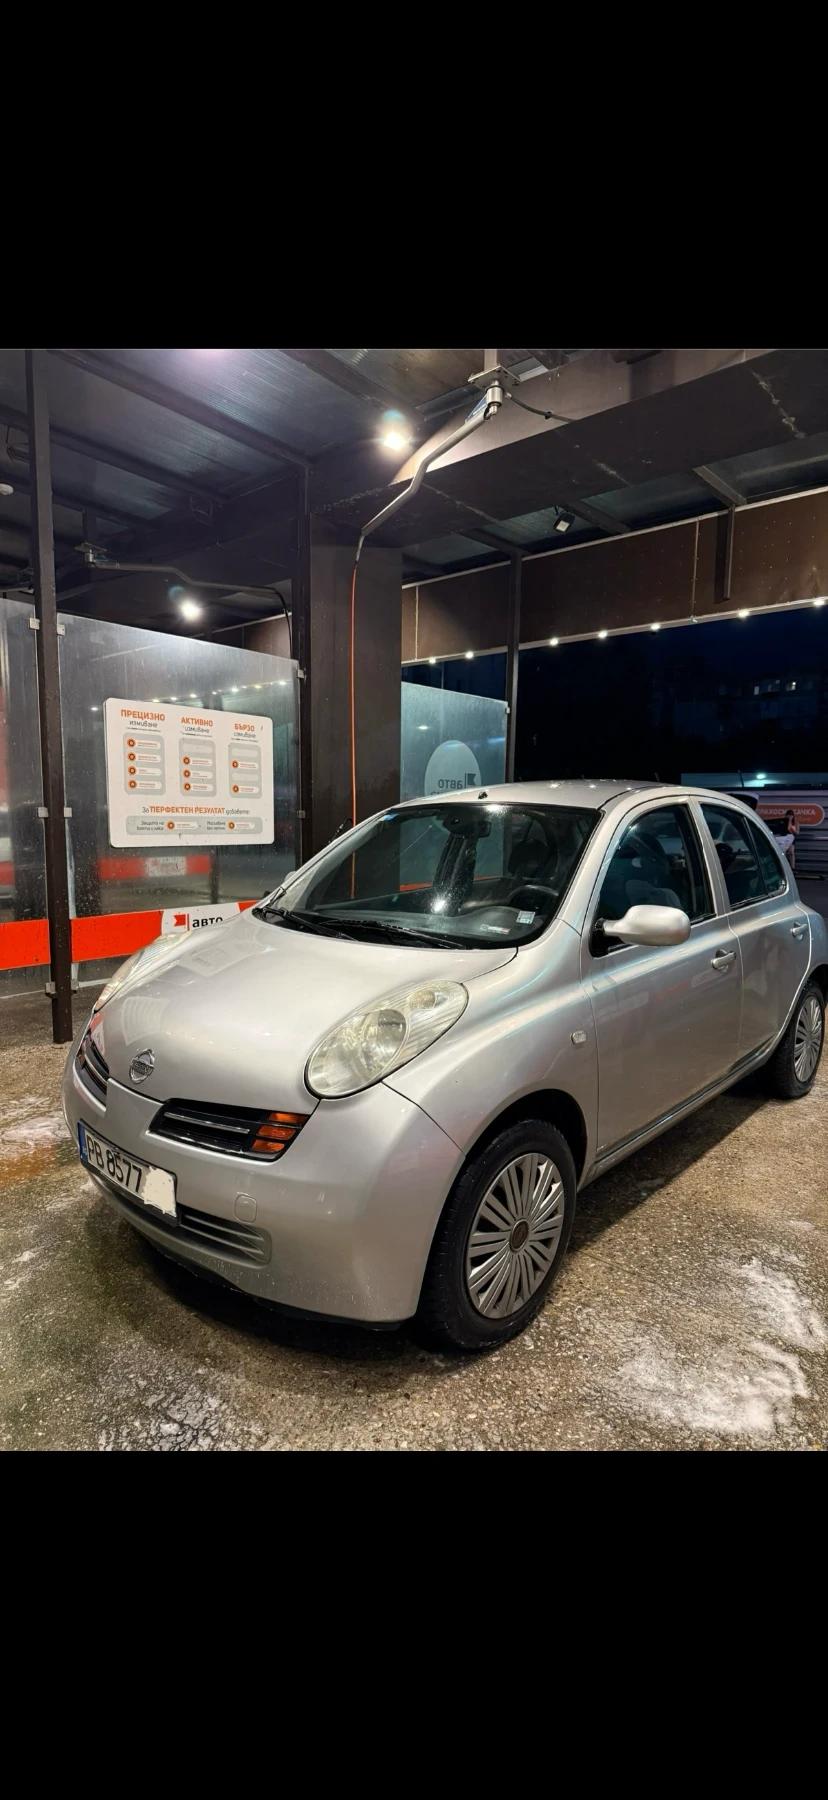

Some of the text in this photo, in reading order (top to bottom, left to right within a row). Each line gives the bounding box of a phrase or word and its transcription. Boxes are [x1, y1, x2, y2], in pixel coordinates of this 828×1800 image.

[120, 709, 166, 721] ПРЕЦИЗНО
[181, 717, 213, 727] АКТИВНО
[234, 723, 255, 732] БЪРЗО
[149, 805, 193, 813] ПЕРФЕКТЕН
[194, 806, 225, 814] РЕЗУЛТАТ
[756, 808, 816, 816] ПРАХОСМКАЧКА
[192, 916, 223, 928] авто
[105, 1148, 143, 1193] 8577
